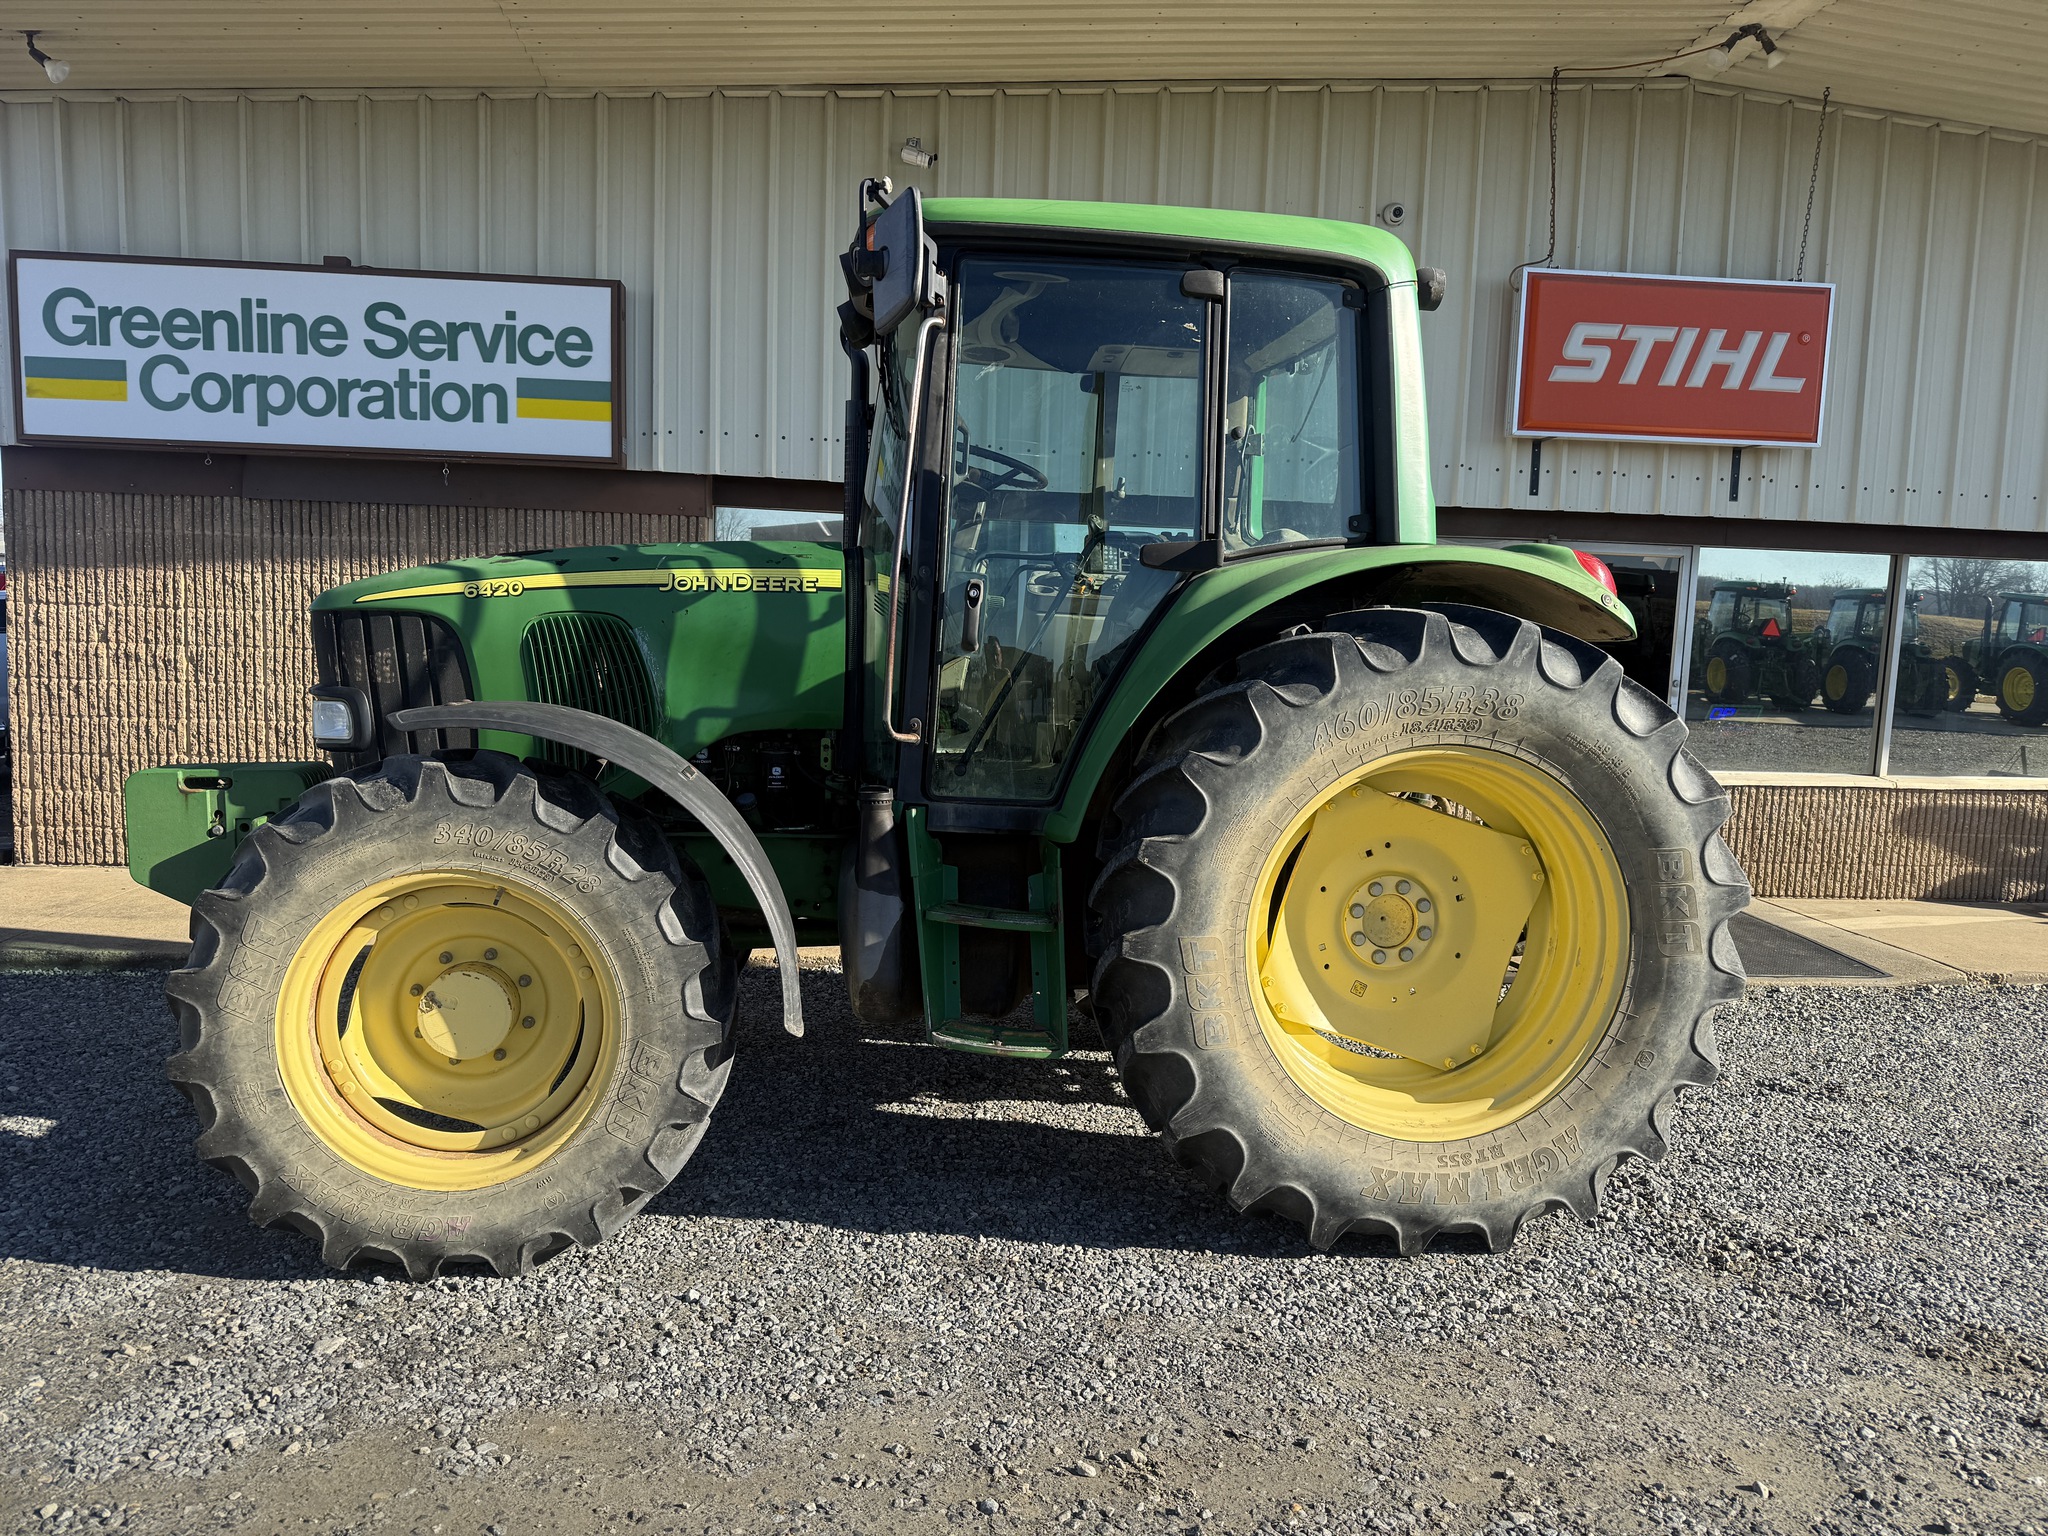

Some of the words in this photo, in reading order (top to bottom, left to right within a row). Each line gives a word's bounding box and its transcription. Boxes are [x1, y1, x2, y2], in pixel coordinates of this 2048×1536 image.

[42, 287, 348, 357] Greenline
[363, 301, 593, 368] Service
[1548, 321, 1806, 394] STIHL
[139, 354, 509, 427] Corporation
[464, 581, 524, 599] 6420
[659, 573, 728, 592] JOHN
[732, 573, 819, 593] DEERE
[1313, 684, 1525, 755] 460/85R38
[433, 822, 602, 894] 340/85R28
[1655, 850, 1696, 953] BKT
[220, 916, 281, 1020] BKT
[1187, 938, 1230, 1048] BKT
[610, 1042, 667, 1143] BKT
